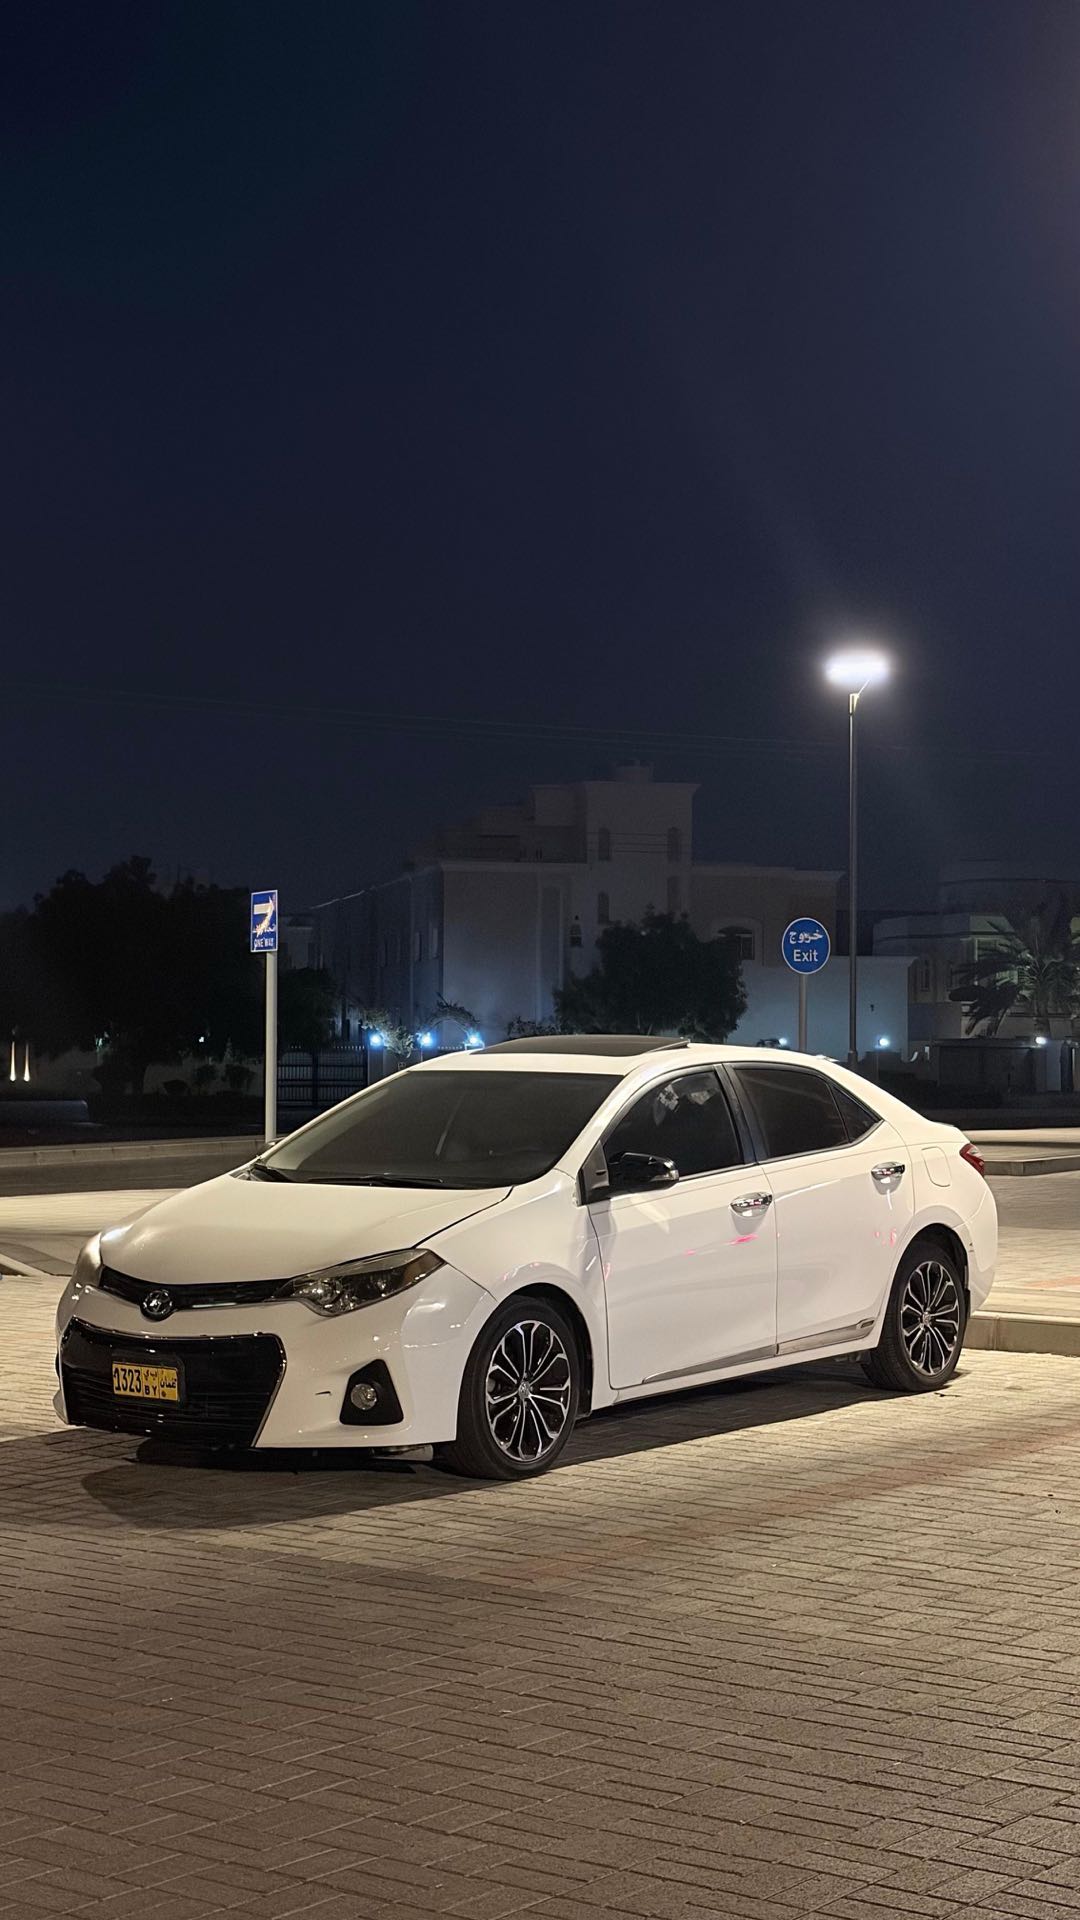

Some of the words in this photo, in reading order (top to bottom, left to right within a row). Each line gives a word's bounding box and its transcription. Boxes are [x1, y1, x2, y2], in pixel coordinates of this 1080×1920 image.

[789, 930, 823, 944] خروج
[793, 949, 818, 961] Exit
[113, 1368, 141, 1393] 1323
